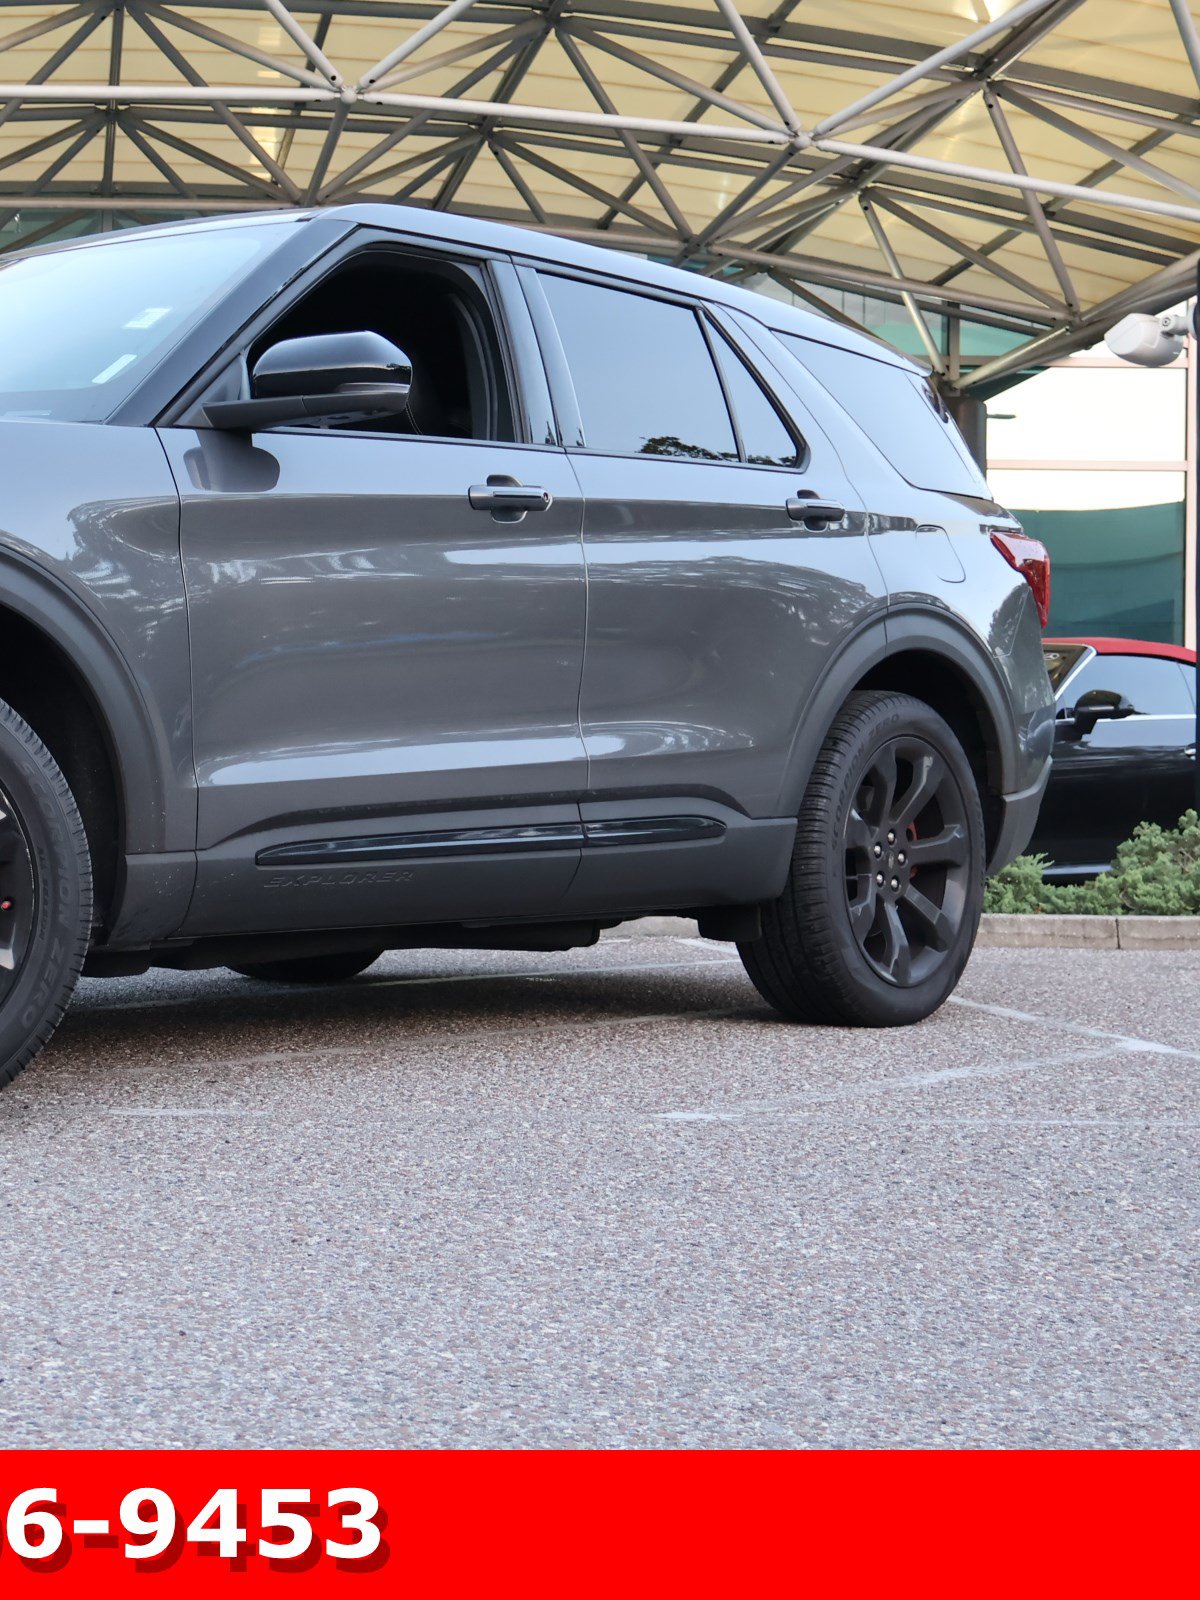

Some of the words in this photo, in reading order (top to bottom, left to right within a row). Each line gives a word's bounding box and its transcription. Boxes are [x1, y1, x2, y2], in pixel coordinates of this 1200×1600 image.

[15, 761, 74, 929] SCORPION
[263, 870, 416, 889] EXPLORER
[23, 938, 64, 1029] ZERO
